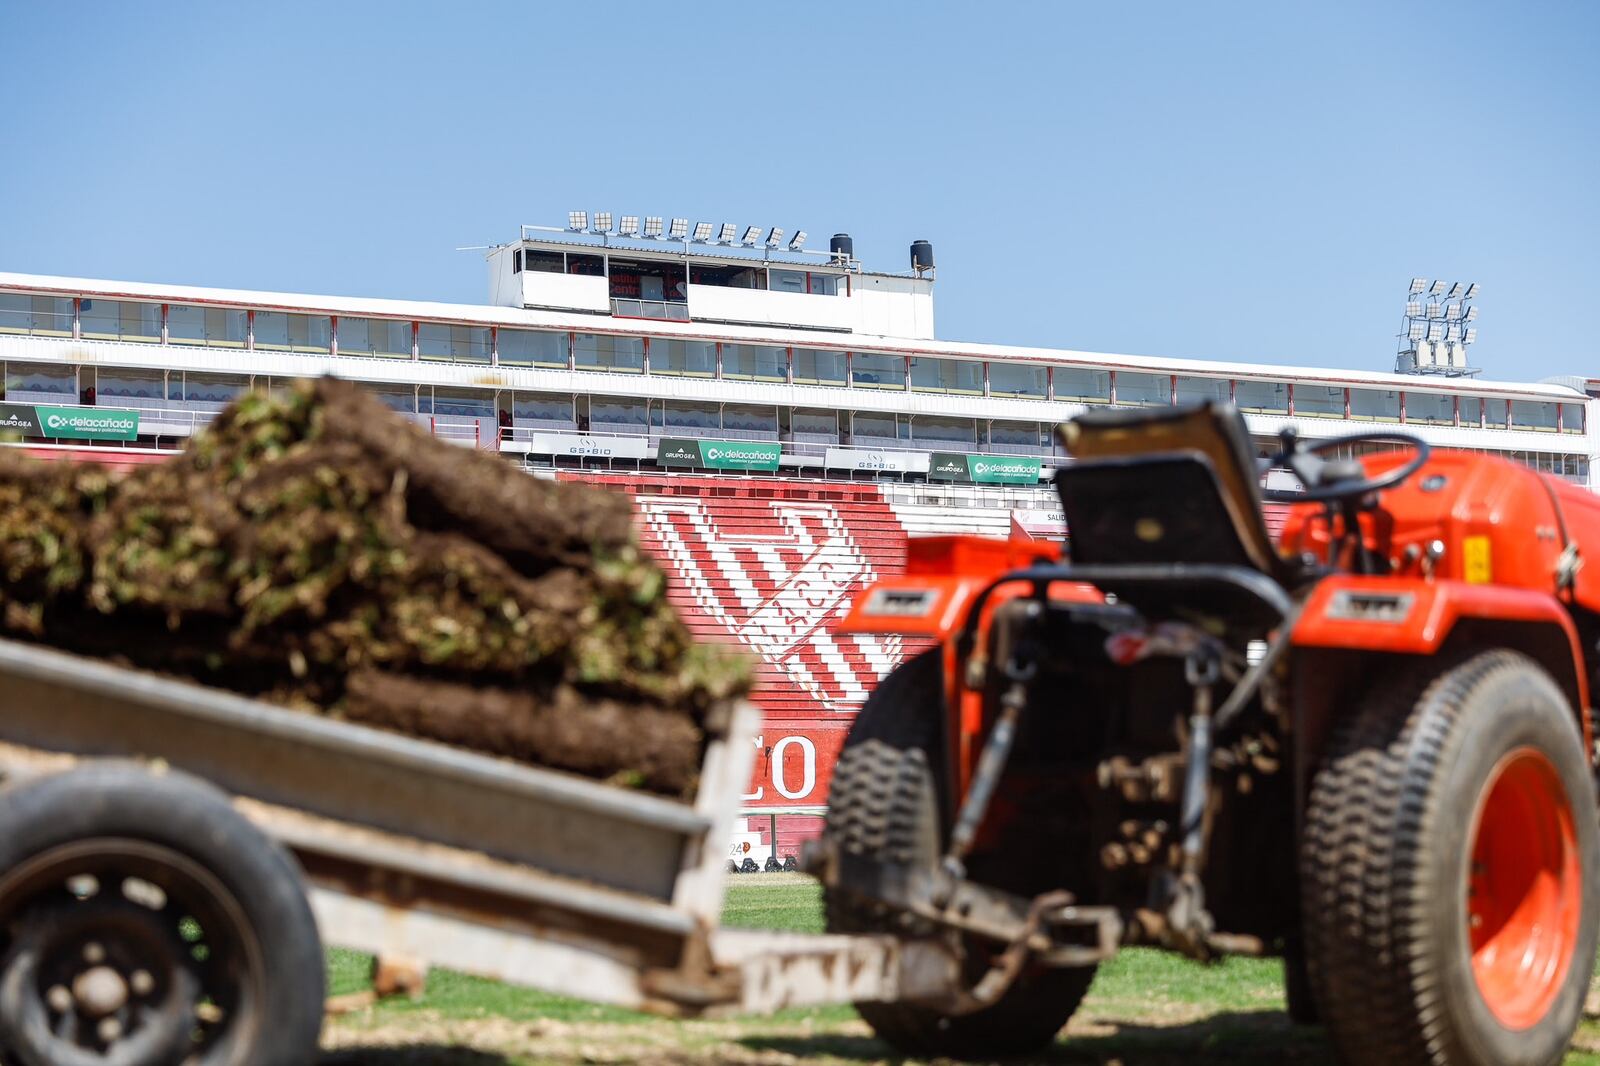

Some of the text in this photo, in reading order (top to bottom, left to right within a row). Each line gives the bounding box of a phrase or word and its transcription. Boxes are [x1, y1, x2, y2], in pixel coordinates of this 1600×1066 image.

[0, 419, 17, 427] RUPO
[69, 417, 134, 428] delacañada
[725, 449, 777, 460] delacañada
[990, 464, 1037, 474] delacañada
